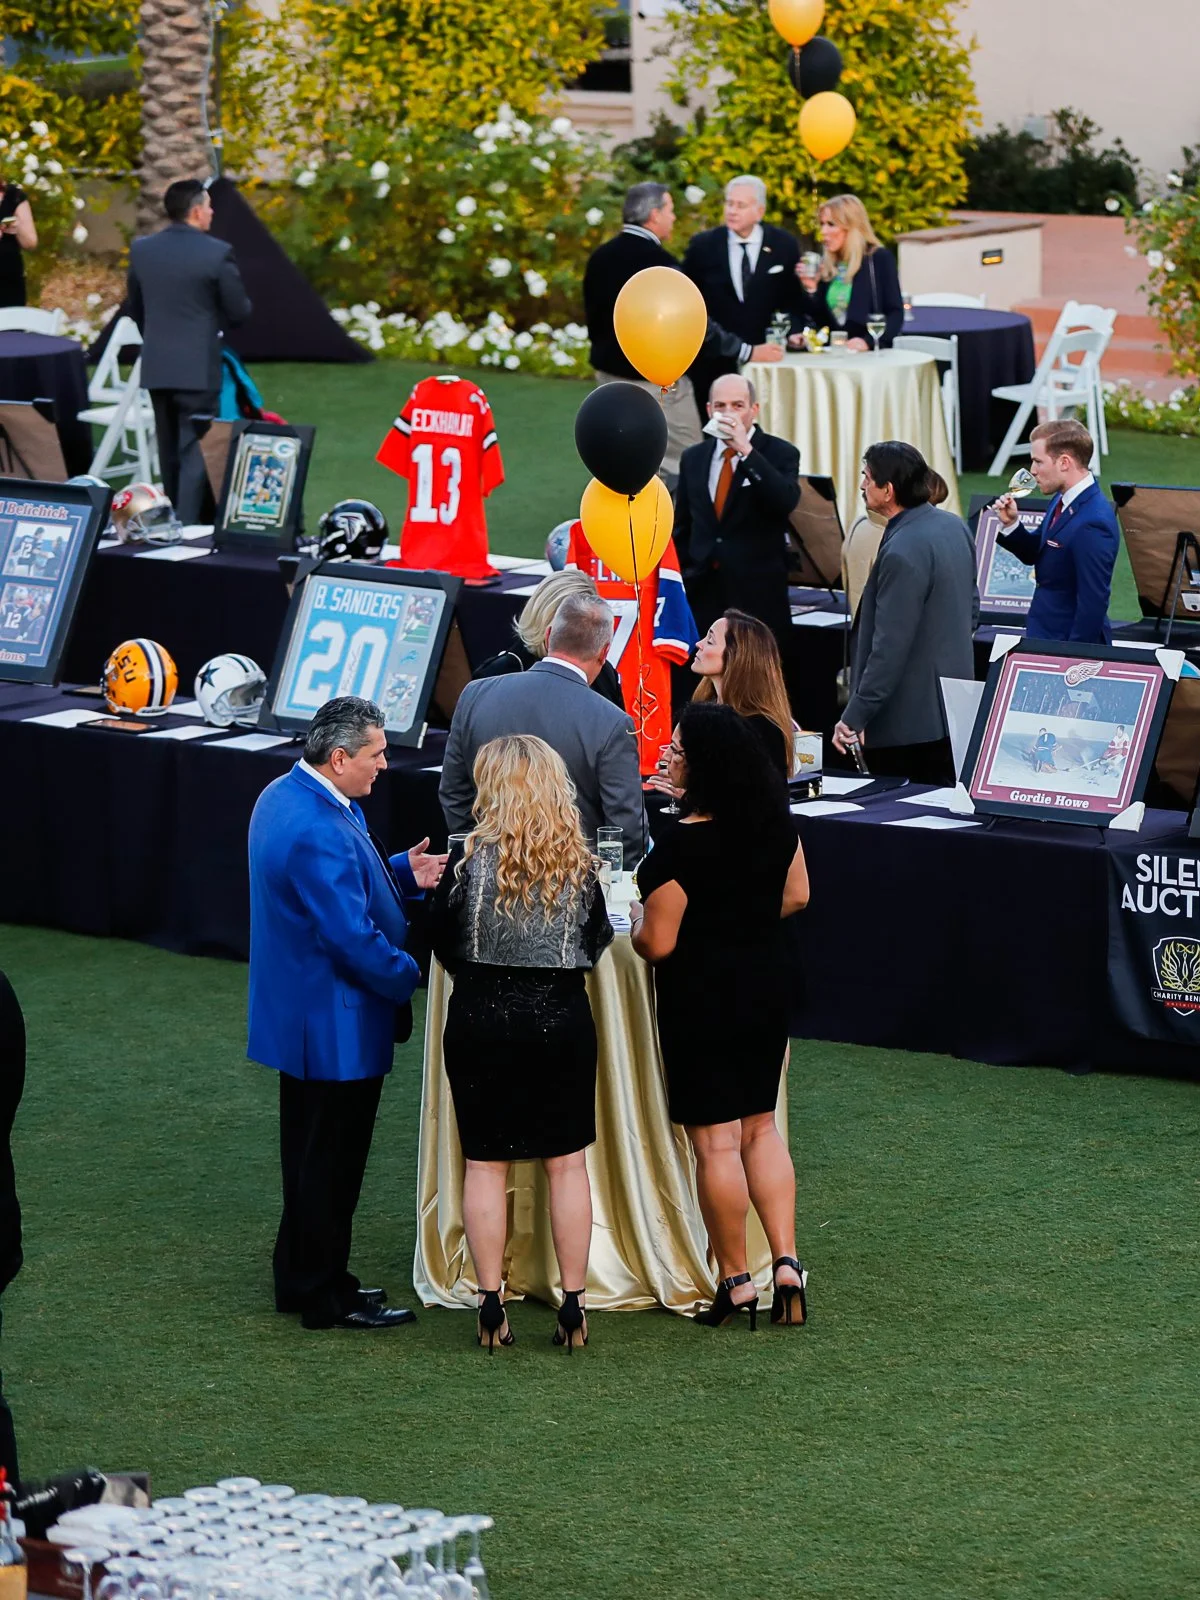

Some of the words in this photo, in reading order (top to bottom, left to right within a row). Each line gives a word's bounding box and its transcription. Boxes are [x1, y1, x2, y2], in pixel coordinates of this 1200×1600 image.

[410, 443, 462, 526] 13
[5, 502, 69, 520] Belichick
[314, 585, 327, 610] B.
[330, 587, 403, 620] SANDERS
[654, 597, 666, 627] 7
[4, 611, 22, 629] 12
[604, 599, 638, 669] 7
[291, 620, 389, 707] 20
[1009, 790, 1052, 805] Gordie
[1054, 795, 1089, 809] Howe
[1153, 991, 1182, 1000] CHARITY
